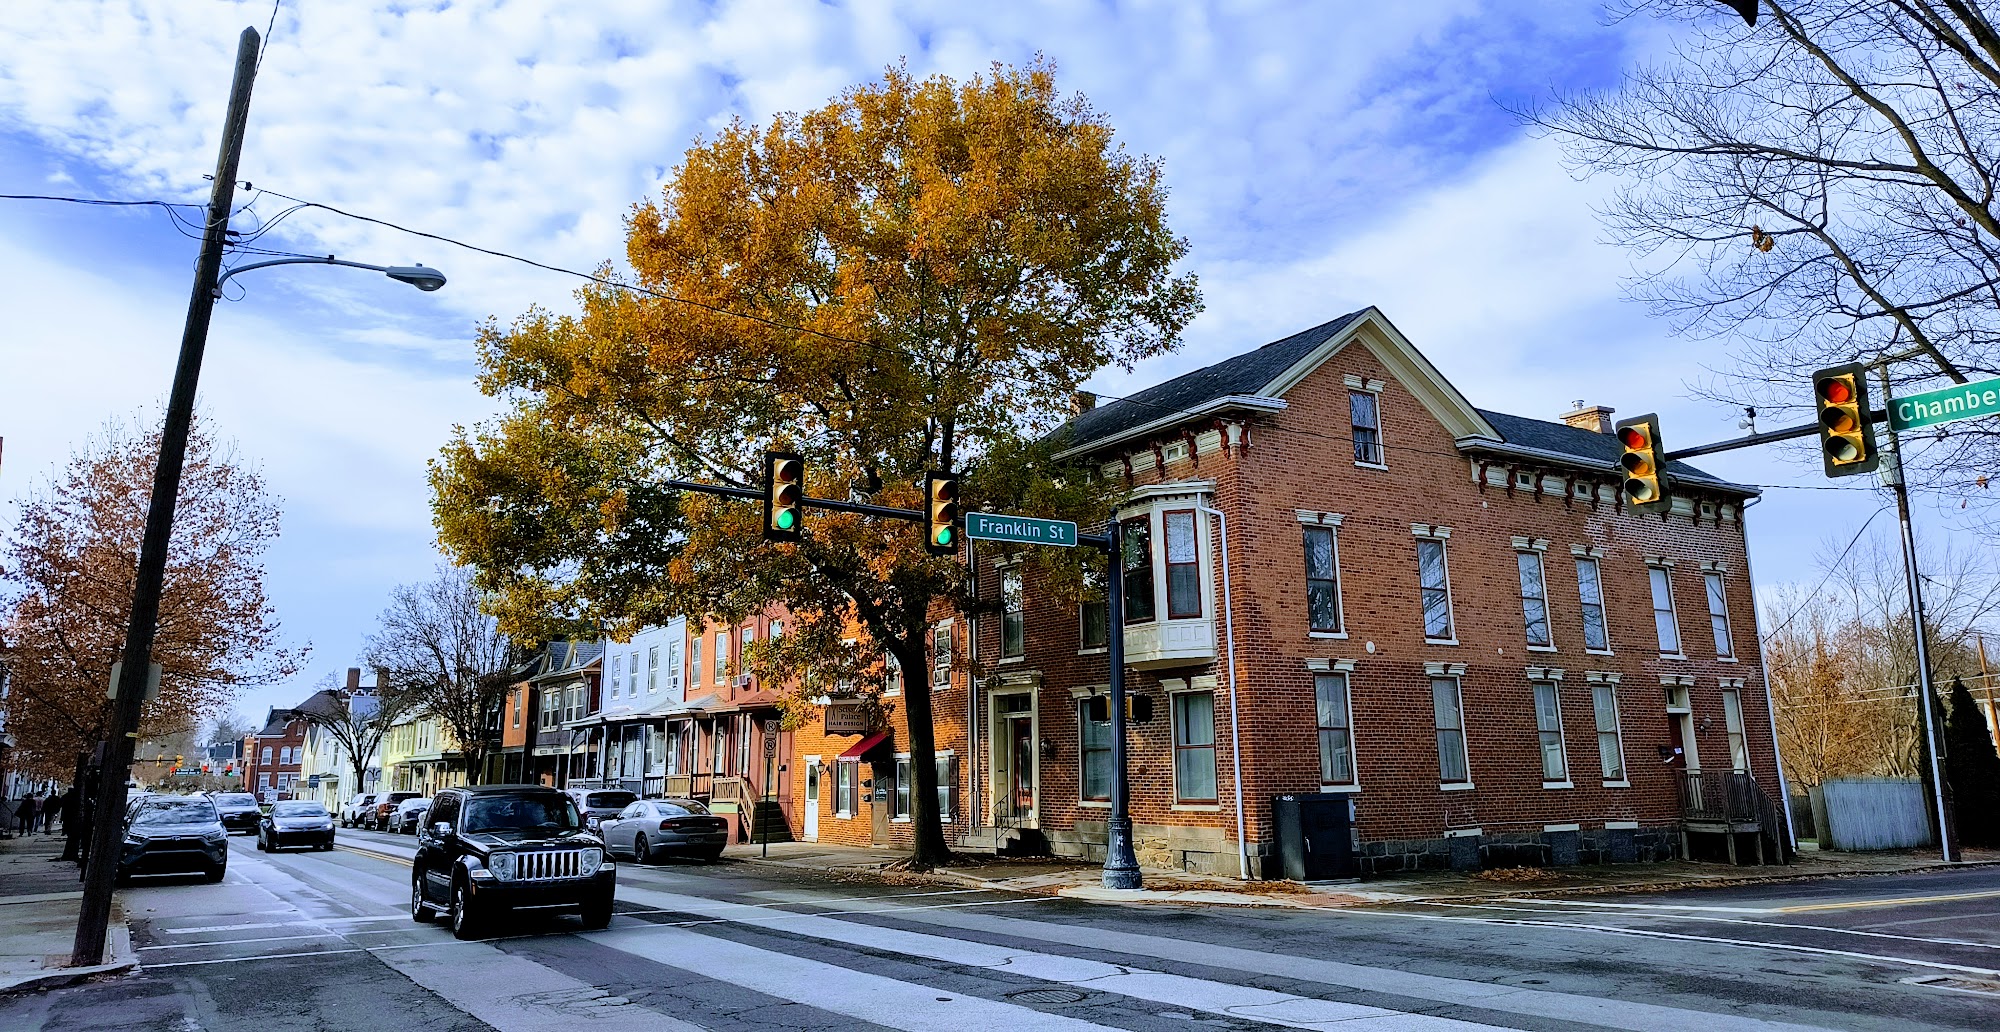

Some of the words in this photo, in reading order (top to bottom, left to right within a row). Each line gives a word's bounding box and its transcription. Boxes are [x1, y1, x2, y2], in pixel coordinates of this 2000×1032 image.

[1898, 388, 2000, 422] Chambe
[979, 518, 1041, 538] Franklin
[1049, 524, 1065, 540] St
